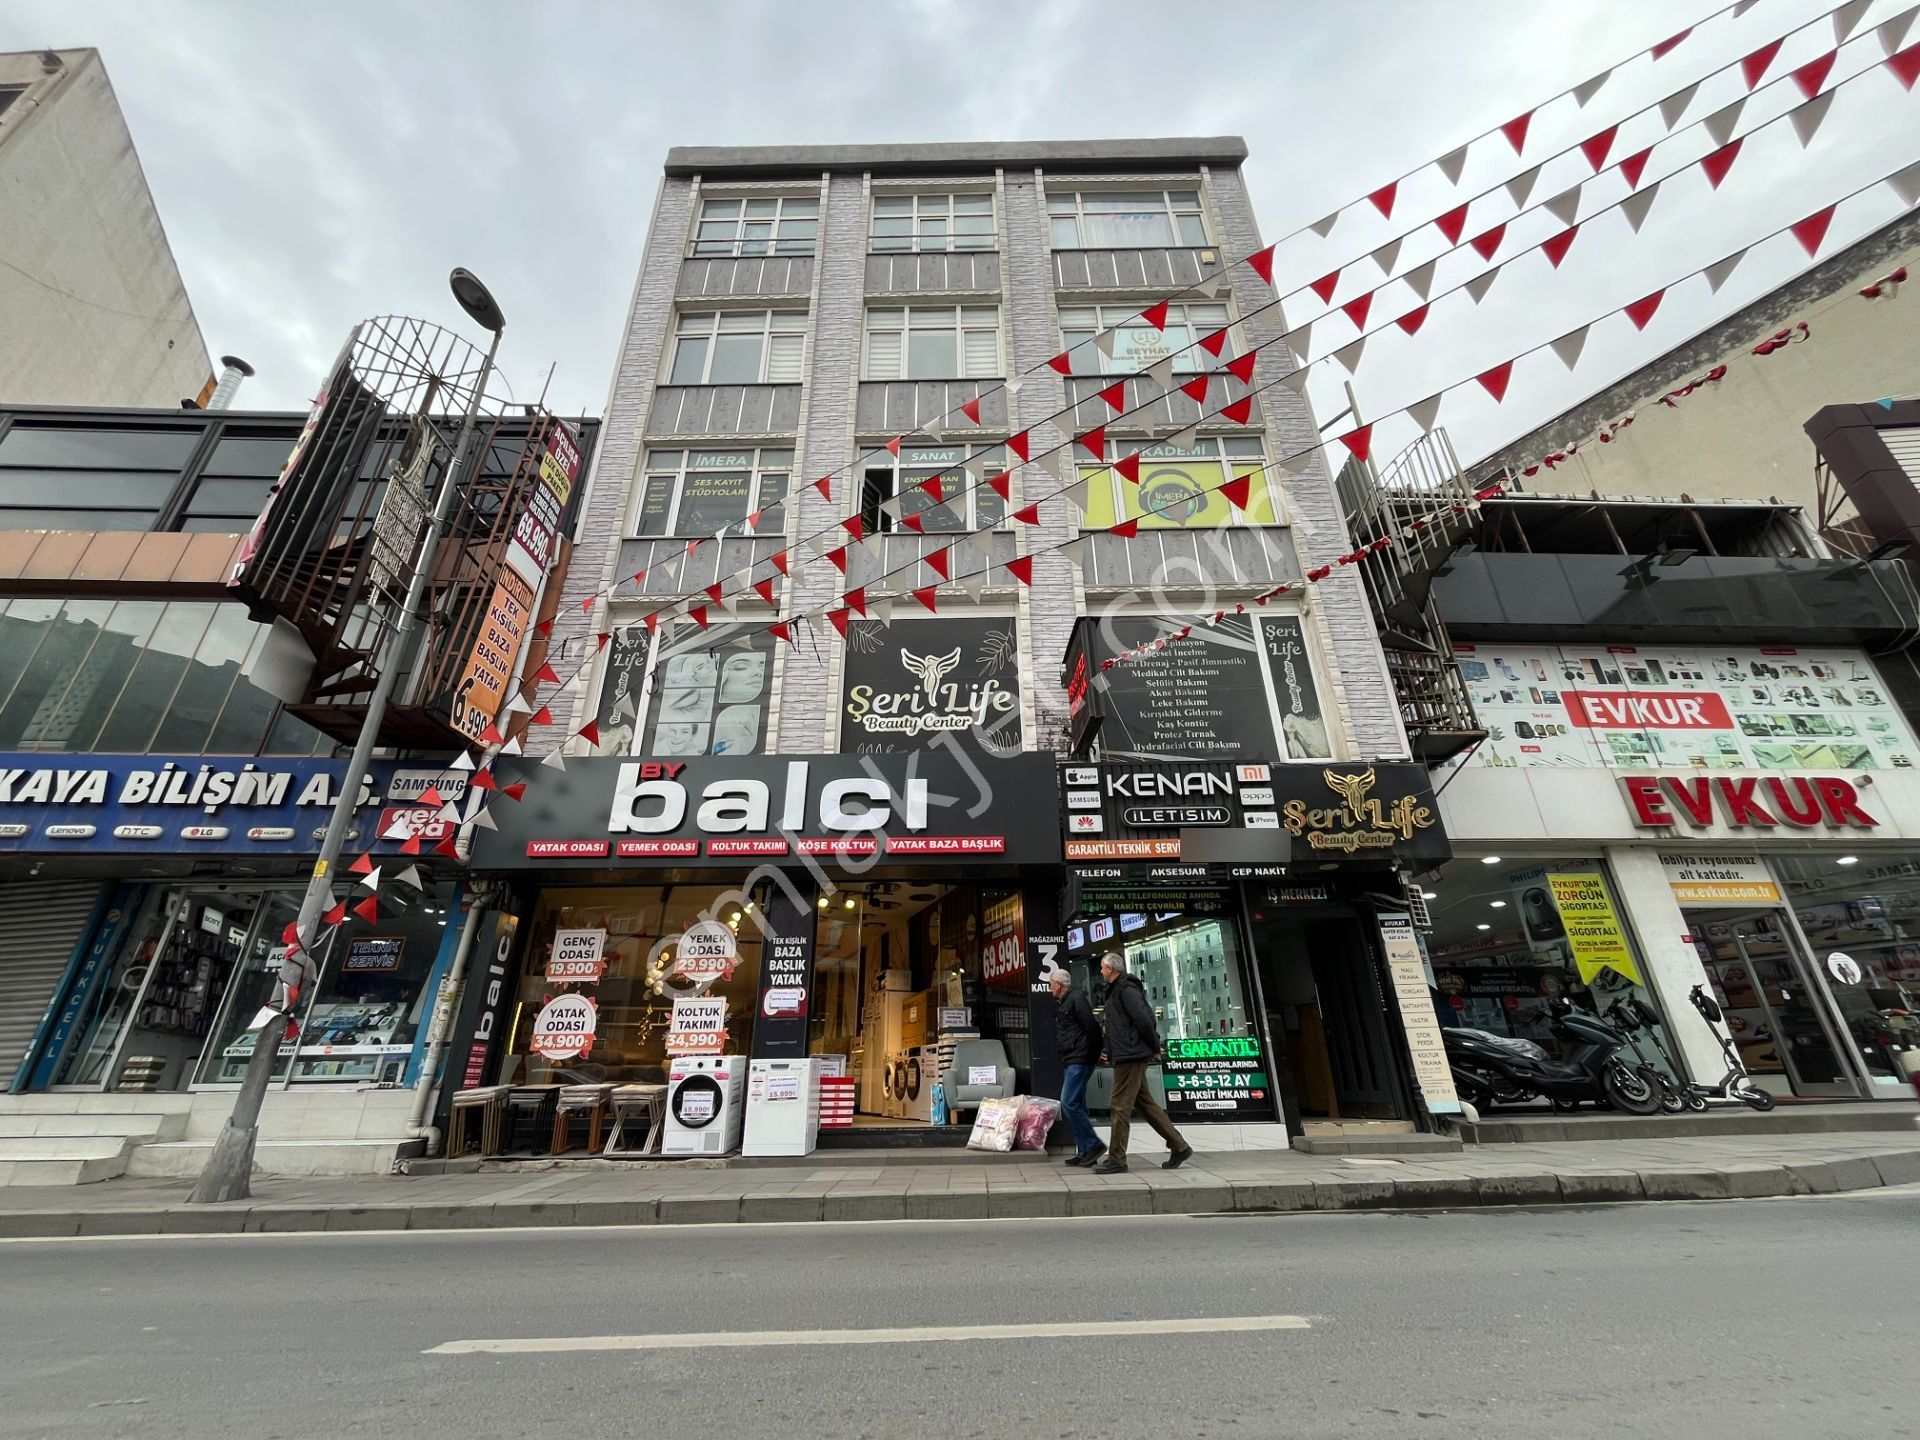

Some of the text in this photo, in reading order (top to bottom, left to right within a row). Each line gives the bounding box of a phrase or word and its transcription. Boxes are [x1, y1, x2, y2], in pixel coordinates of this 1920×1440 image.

[696, 454, 747, 466] İMERA
[911, 452, 955, 461] SANAT
[694, 479, 712, 487] SES
[685, 488, 748, 496] STÜDYOLARI
[503, 597, 519, 619] TEK
[490, 606, 520, 640] KİŞİLİK
[1265, 624, 1299, 640] Şeri
[488, 629, 511, 655] BAZA
[1268, 641, 1303, 660] Life
[613, 652, 645, 672] Life
[473, 664, 500, 693] YATAK
[1132, 670, 1168, 678] Medikal
[1169, 669, 1186, 677] Cilt
[1176, 678, 1208, 686] Bakımı
[1175, 688, 1208, 696] Bakımı
[847, 679, 1015, 726] Şeri Life
[1151, 699, 1208, 707] Leke Bakımı
[1184, 708, 1223, 717] Giderme
[865, 714, 971, 734] Beauty Center
[1156, 718, 1210, 730] Kaş Kontür
[1153, 729, 1216, 739] Protez Tırnak
[1133, 739, 1241, 752] Hydrafacial Cilt Bakımı
[640, 762, 684, 778] BY
[118, 762, 292, 813] BİLİŞİM
[392, 778, 465, 792] SAMSUNG
[1106, 771, 1233, 797] KENAN
[608, 761, 928, 833] balcı
[1622, 776, 1881, 829] EVKUR
[1283, 795, 1436, 840] Şeri Life
[200, 828, 213, 837] LG
[711, 842, 785, 851] KOLTUK TAKIMI
[798, 840, 876, 851] KÖŞE KOLTUK
[891, 839, 1003, 850] YATAK BAZA BAŞLIK
[1312, 831, 1394, 851] Beauty Center
[532, 843, 604, 852] YATAK ODASI
[621, 843, 696, 852] YEMEK ODASI
[1068, 841, 1116, 855] GARANTİLİ
[1117, 840, 1152, 854] TEKNİK
[1699, 855, 1756, 867] reyonumuz
[1075, 869, 1121, 877] TELEFON
[1151, 867, 1206, 876] AKSESUAR
[1232, 866, 1286, 876] CEP NAKİT
[1680, 868, 1744, 880] alt kattadır.
[1552, 880, 1600, 889] EVKUR'DAN
[1805, 879, 1826, 889] LG
[1267, 884, 1328, 903] İŞ MERKEZİ
[1556, 888, 1605, 901] ZORGÜN
[1113, 902, 1185, 910] NAKİTE ÇEVRİLİR
[1560, 902, 1608, 911] SİGORTASI
[1568, 927, 1618, 936] SİGORTALI
[563, 937, 596, 948] GENÇ
[690, 934, 727, 943] YEMEK
[785, 936, 807, 945] KİŞİLİK
[1029, 935, 1065, 944] MAĞAZAMIZ
[352, 939, 401, 954] TEKNİK
[688, 945, 726, 955] ODASI
[774, 946, 802, 957] BAZA
[559, 950, 595, 959] ODASI
[348, 954, 396, 968] SERVİS
[769, 959, 806, 972] BAŞLIK
[1038, 944, 1059, 982] 3
[770, 973, 803, 985] YATAK
[46, 927, 110, 1058] TURKCELL
[550, 1008, 586, 1018] YATAK
[677, 1007, 720, 1017] KOLTUK
[546, 1021, 585, 1031] ODASI
[679, 1020, 717, 1030] TAKIMI
[1166, 1060, 1258, 1069] TÜM CEP TELEFONLARINDA
[1177, 1074, 1251, 1087] 3-6-9-12 AY
[1184, 1087, 1250, 1100] TAKSİT İMKANI
